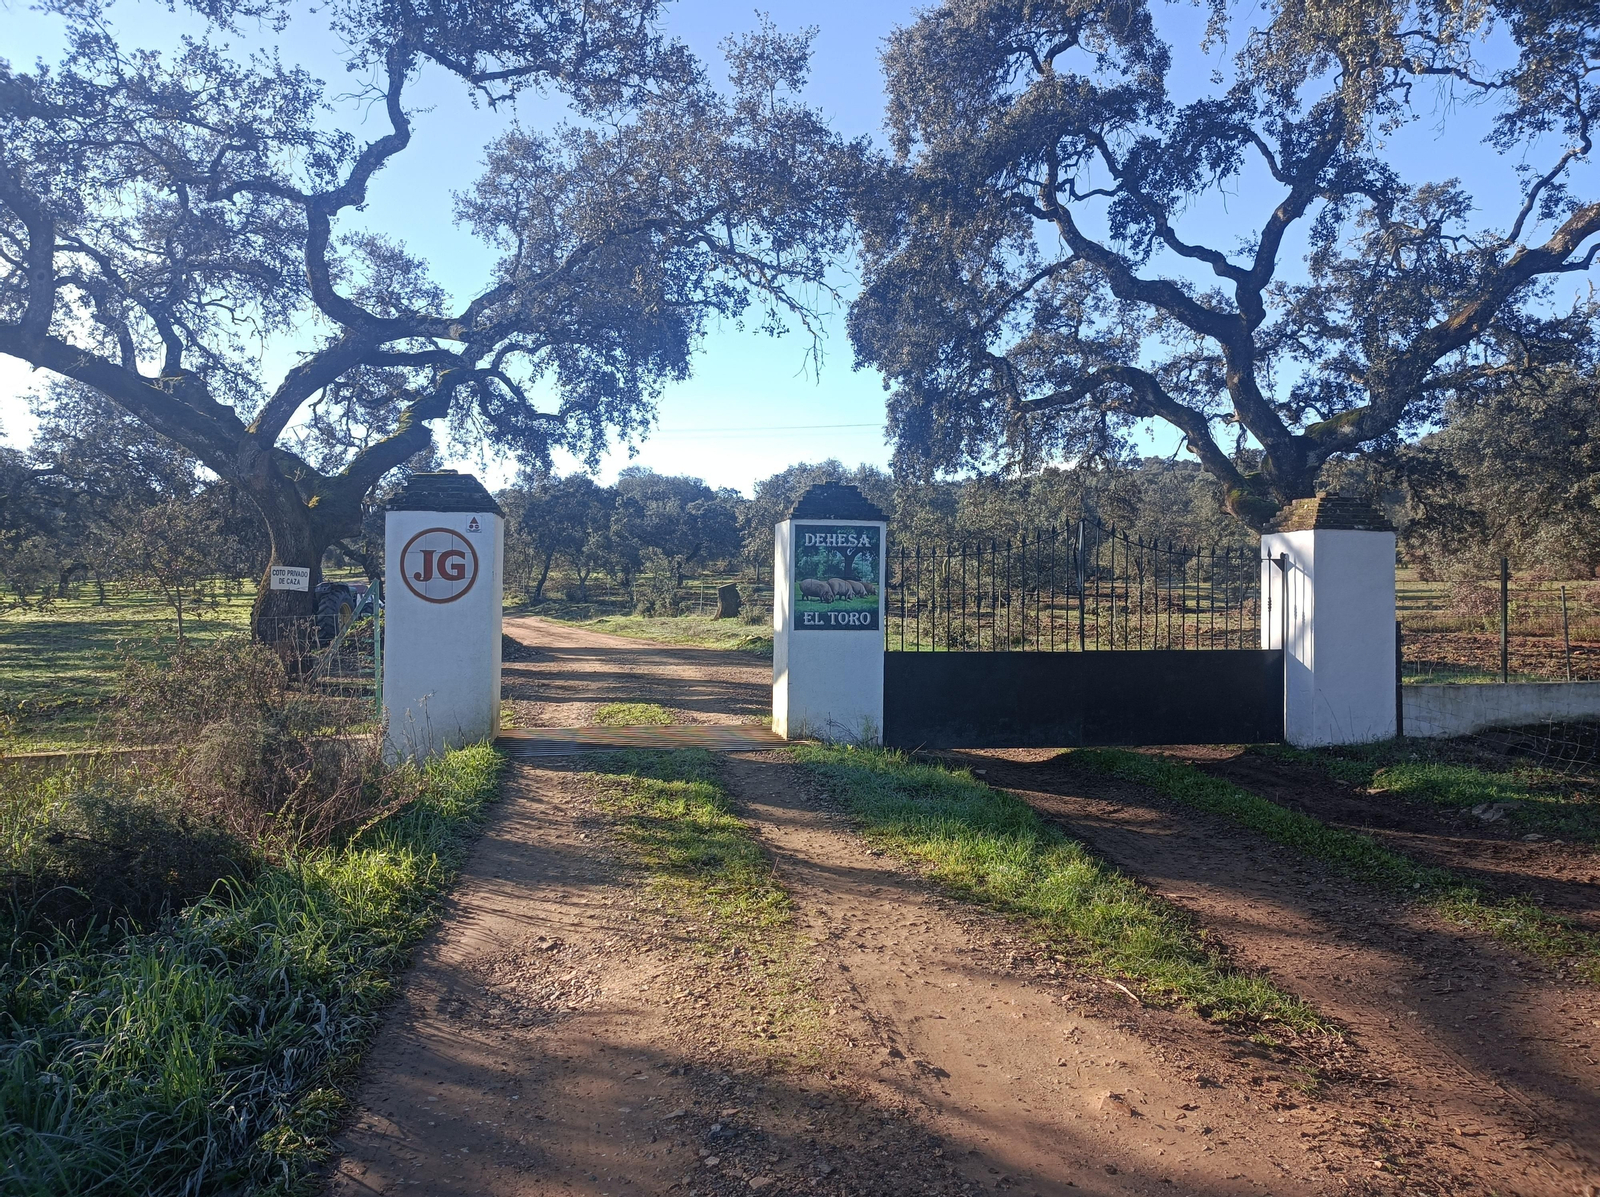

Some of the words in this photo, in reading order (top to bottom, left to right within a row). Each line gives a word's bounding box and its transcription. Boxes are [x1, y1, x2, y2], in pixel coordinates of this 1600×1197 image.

[804, 533, 871, 547] DEHESA
[413, 549, 466, 582] JG
[287, 570, 308, 578] PRIVADO
[803, 612, 825, 625] EL
[828, 612, 871, 625] TORO
